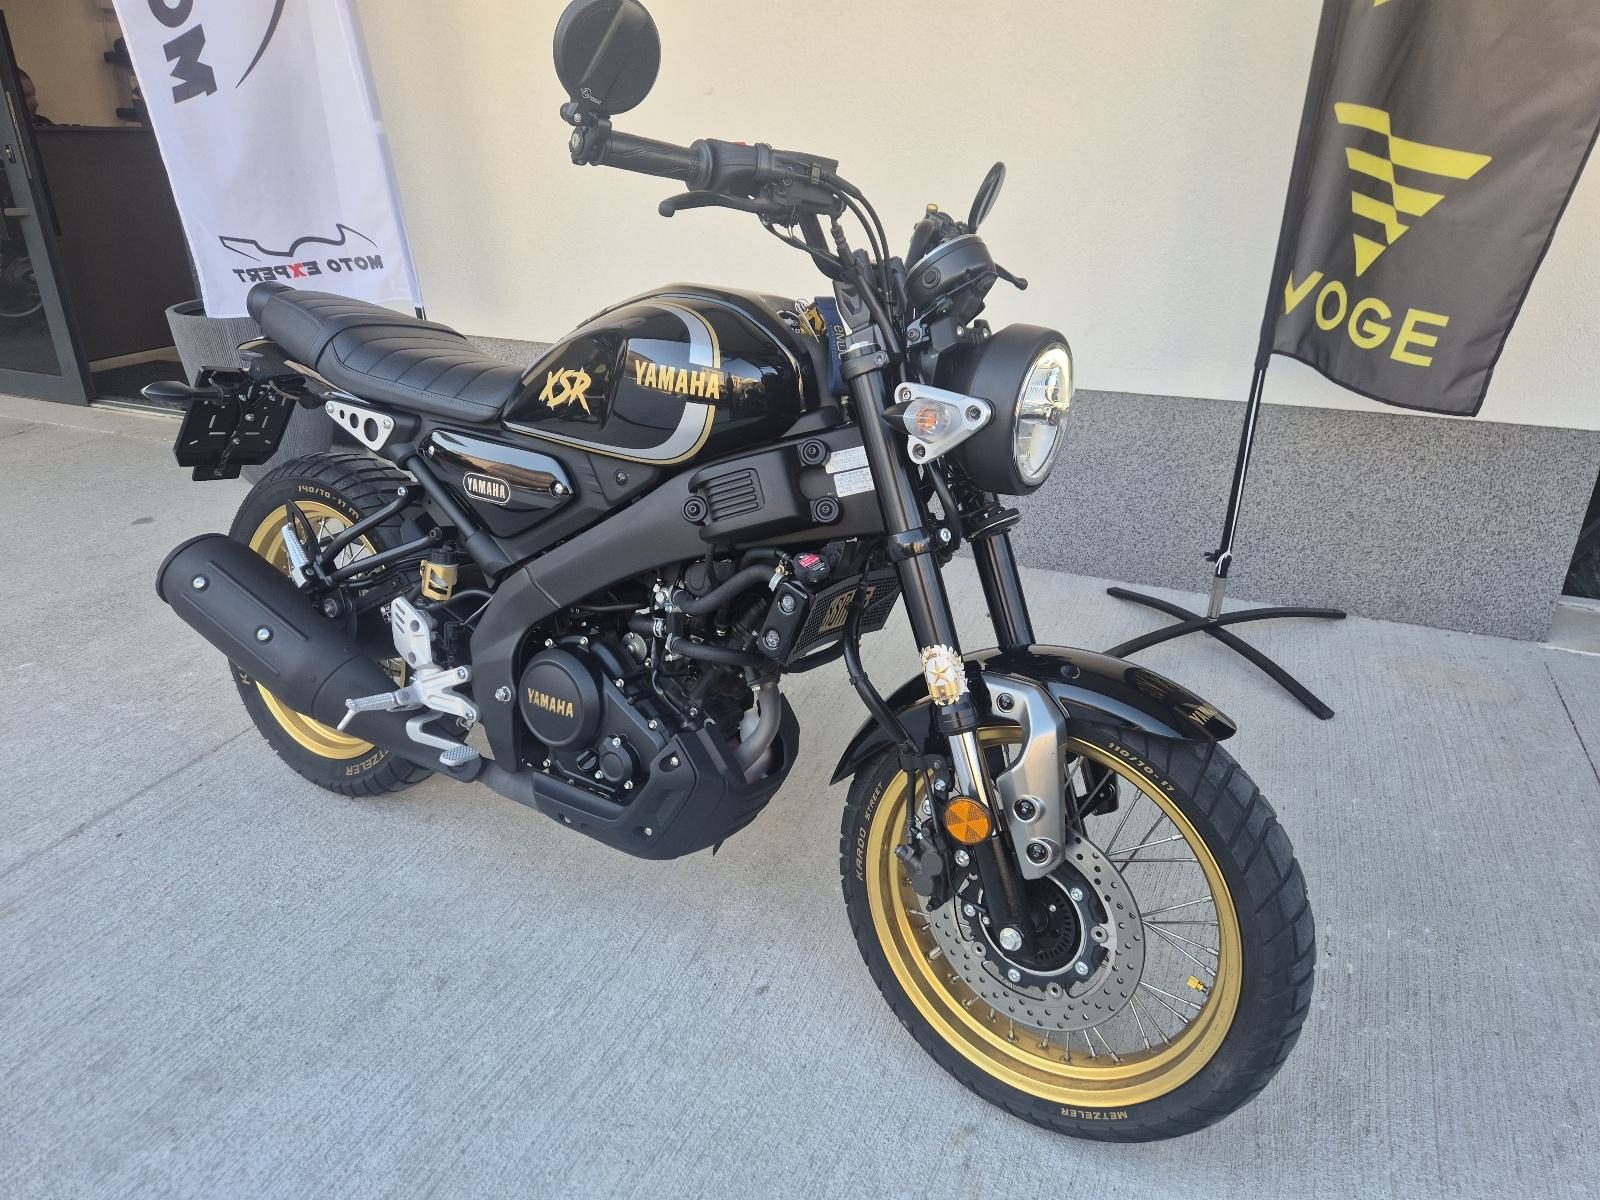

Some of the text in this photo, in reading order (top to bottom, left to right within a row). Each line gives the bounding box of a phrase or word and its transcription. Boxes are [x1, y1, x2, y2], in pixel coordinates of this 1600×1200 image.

[1284, 270, 1450, 367] VOGE
[539, 365, 592, 415] XSR
[634, 359, 720, 400] YAMAHA
[467, 476, 506, 499] YAMAHA
[527, 687, 574, 719] YAMAHA
[864, 781, 883, 821] STREET
[1060, 1107, 1128, 1120] METZELER
